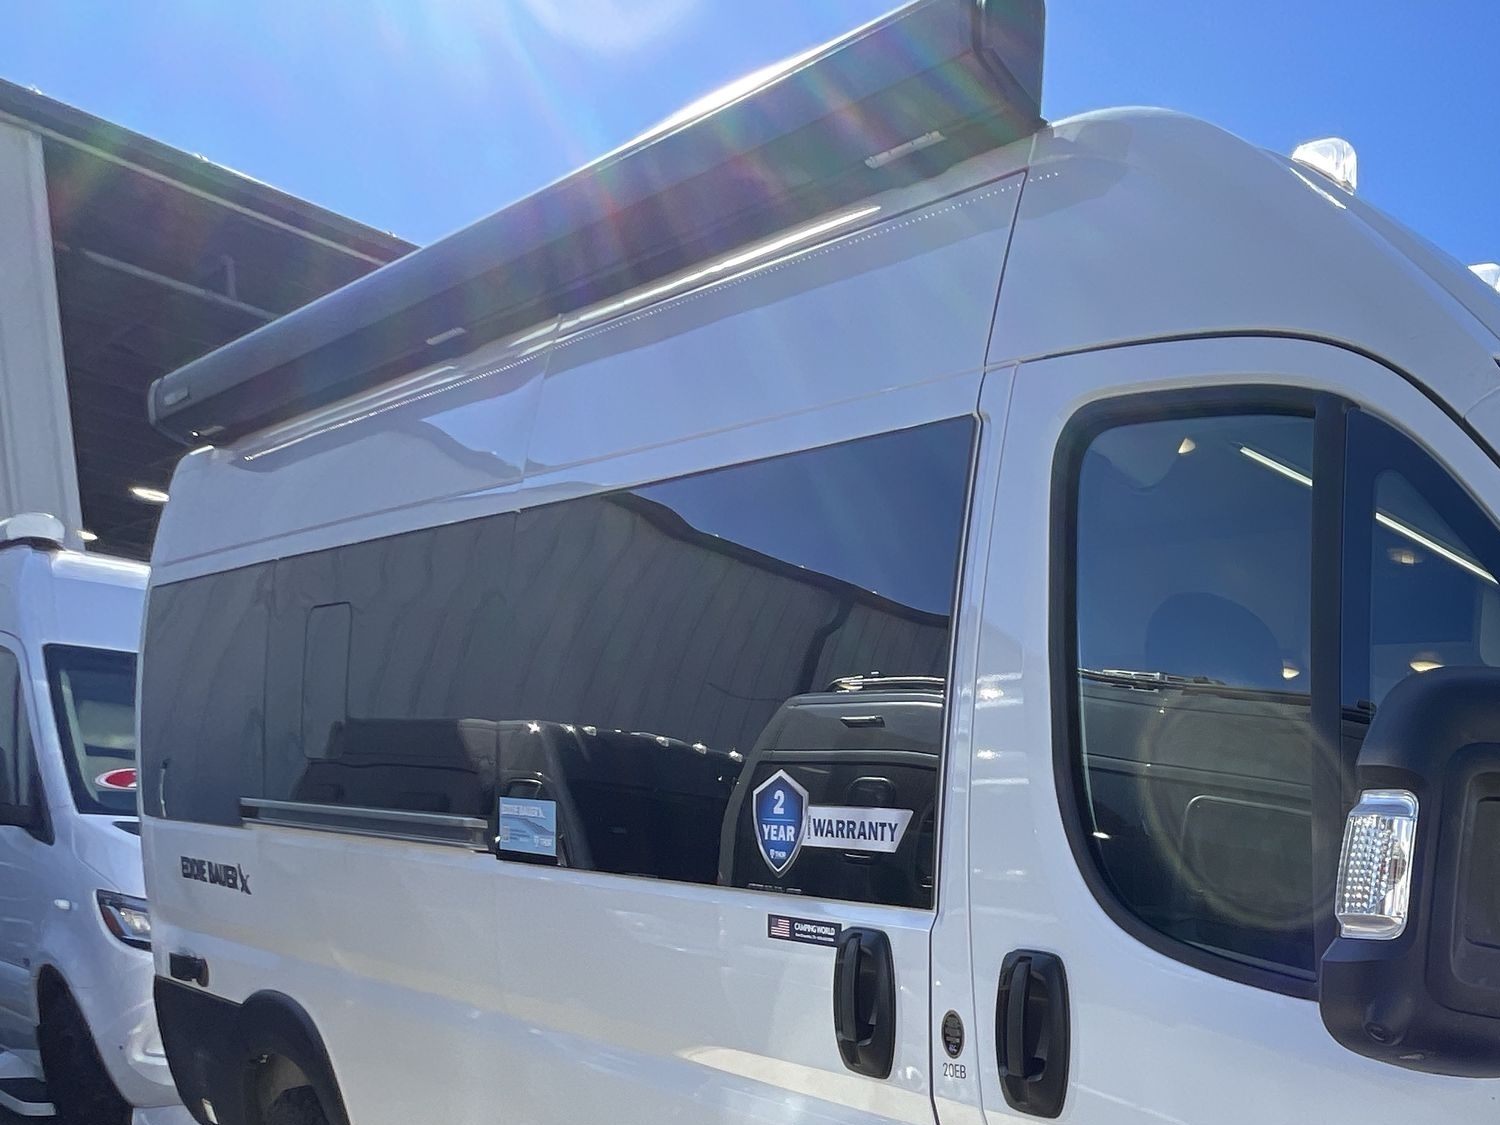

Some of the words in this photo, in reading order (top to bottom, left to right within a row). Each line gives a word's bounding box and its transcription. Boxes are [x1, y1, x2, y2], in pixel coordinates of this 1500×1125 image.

[773, 789, 785, 815] 2
[762, 823, 795, 842] YEAR
[812, 818, 899, 843] WARRANTY
[942, 1062, 967, 1079] 20EB
